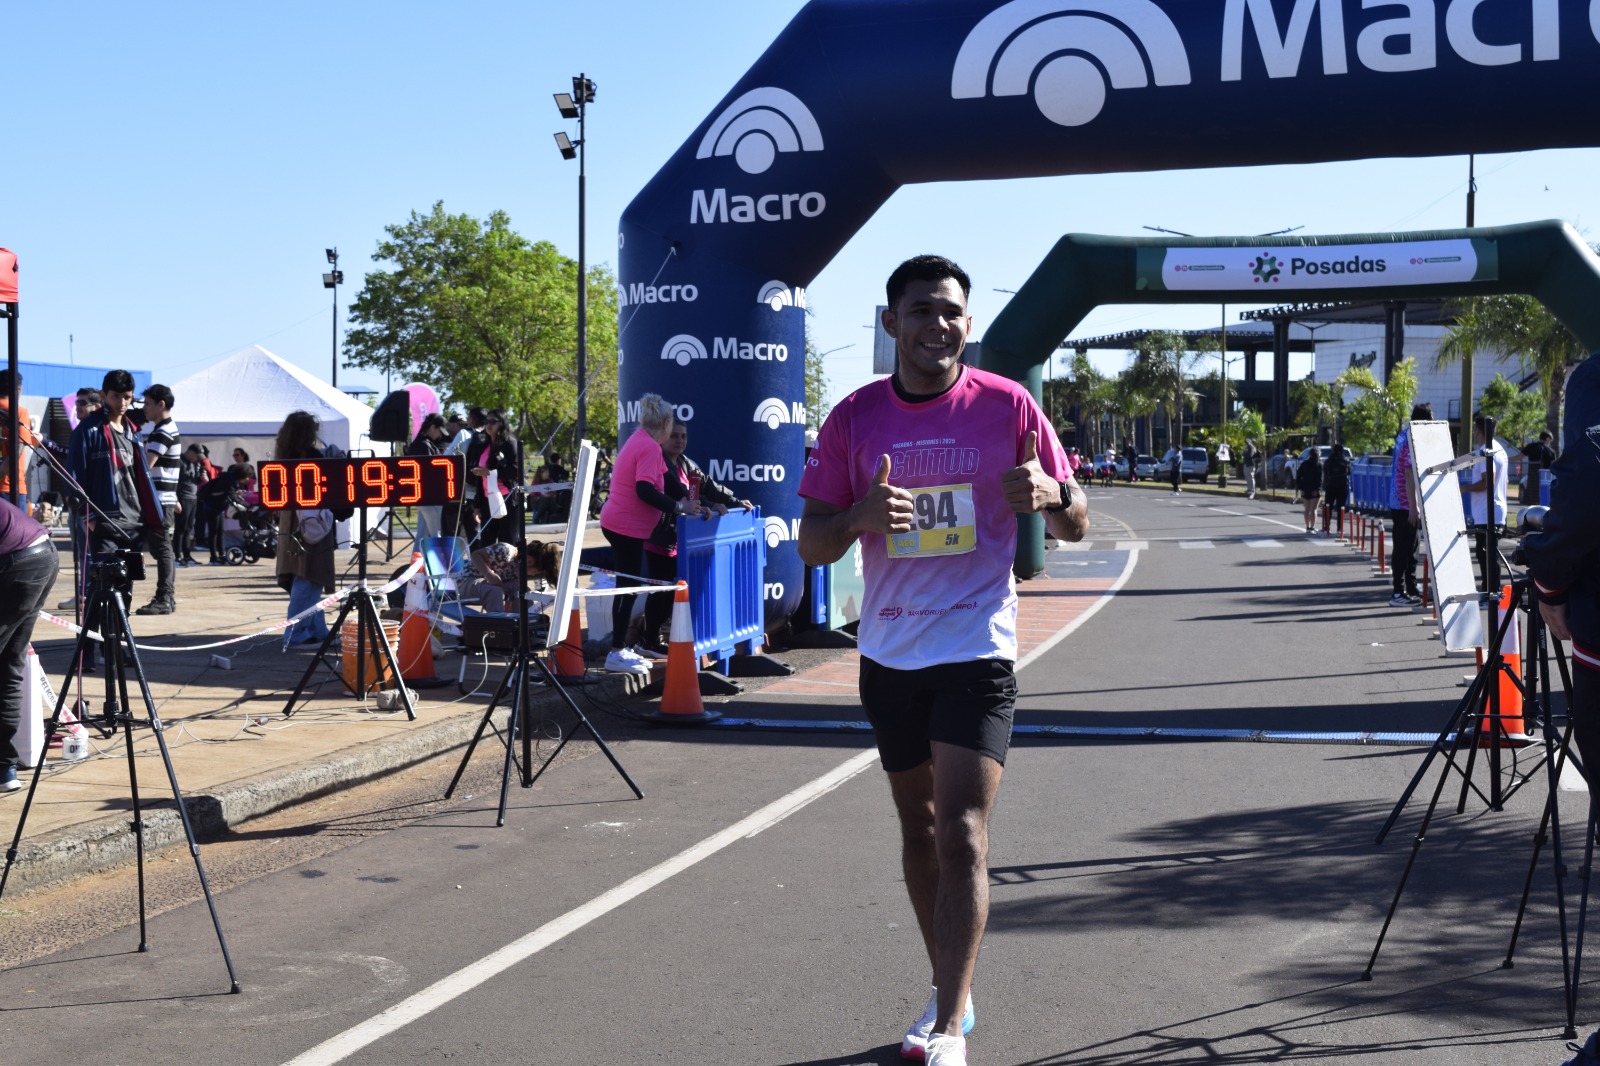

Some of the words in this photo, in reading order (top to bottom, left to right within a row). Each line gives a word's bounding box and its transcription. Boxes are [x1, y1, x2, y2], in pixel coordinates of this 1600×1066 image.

[1220, 0, 1600, 82] Macr
[689, 187, 827, 224] Macro
[1290, 255, 1387, 275] Posadas
[629, 282, 699, 305] Macro
[712, 336, 788, 362] Macro
[261, 458, 456, 507] 00:19:37
[708, 459, 786, 482] Macro
[944, 533, 960, 546] 5k
